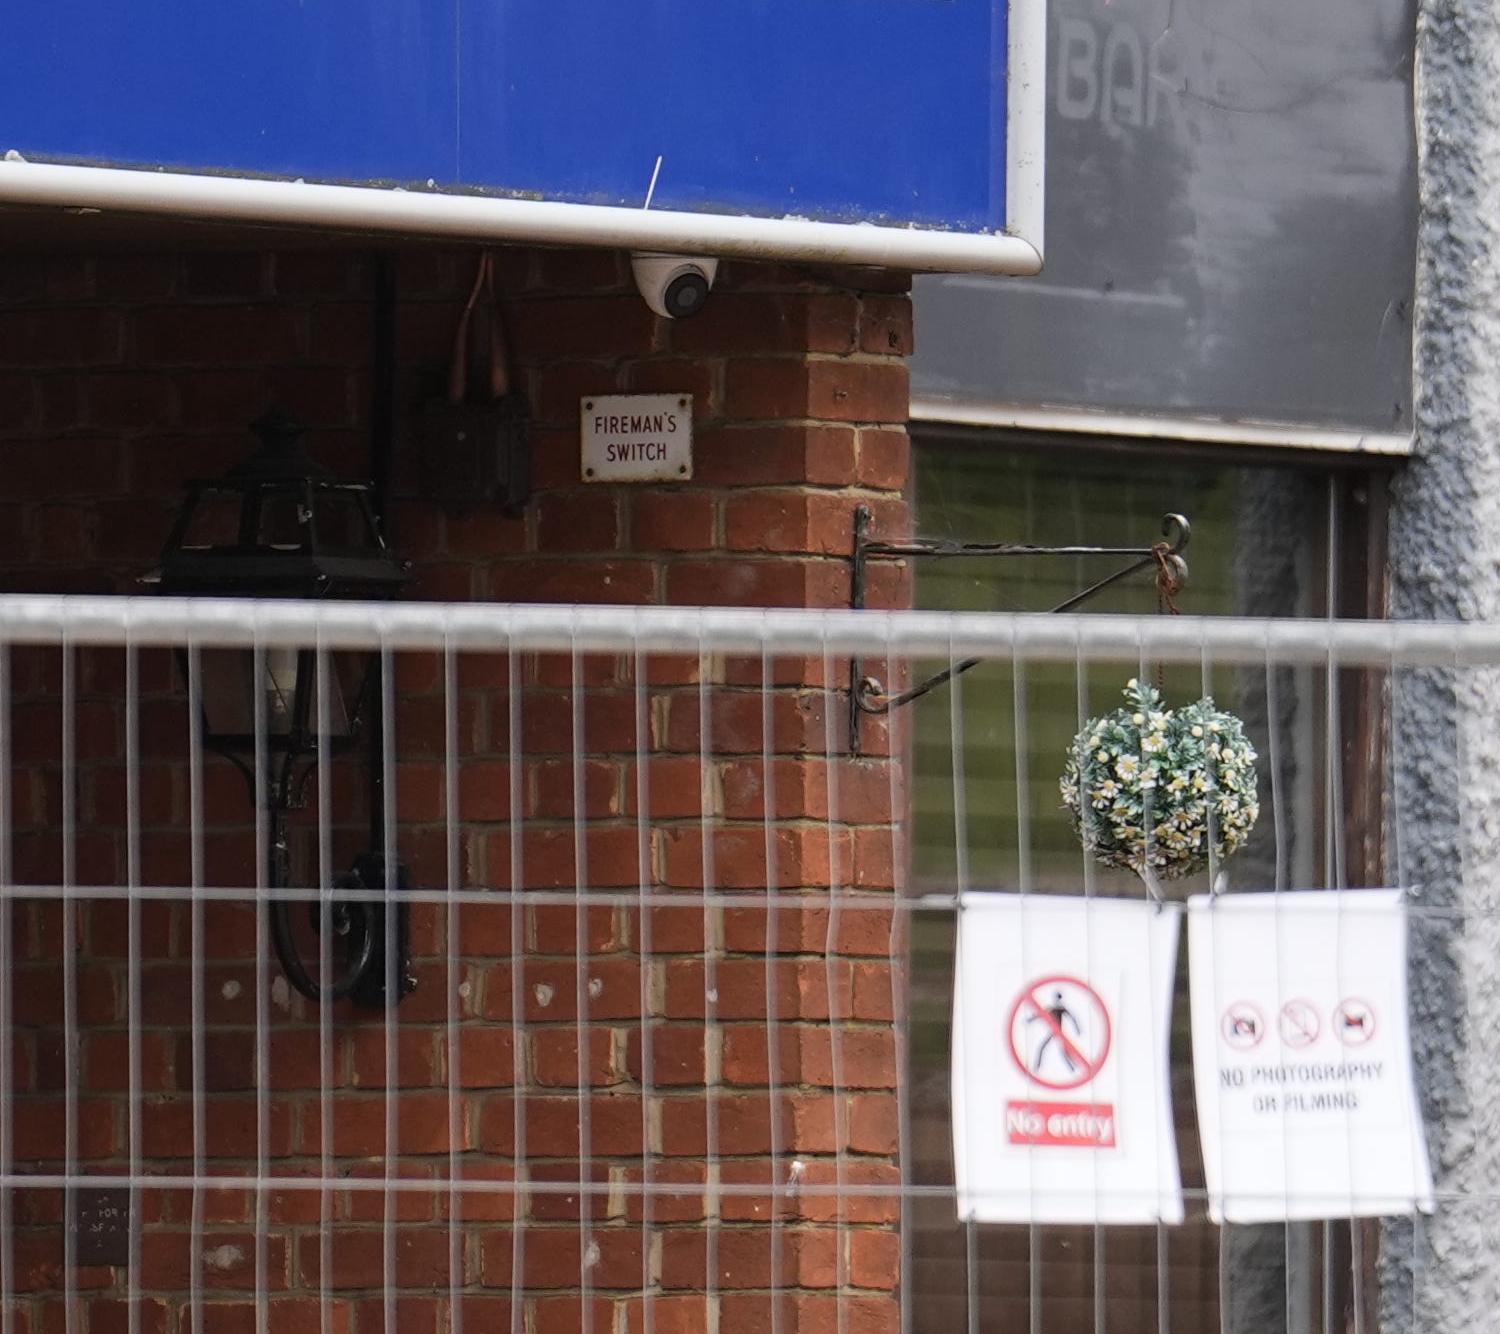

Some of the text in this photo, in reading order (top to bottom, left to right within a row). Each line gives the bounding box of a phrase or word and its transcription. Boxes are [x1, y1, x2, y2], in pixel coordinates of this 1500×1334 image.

[594, 412, 677, 434] FIREMAN'S
[606, 442, 667, 462] SWITCH
[1219, 1061, 1383, 1088] NO PHOTOGRAPHY
[1006, 1108, 1114, 1145] No entry
